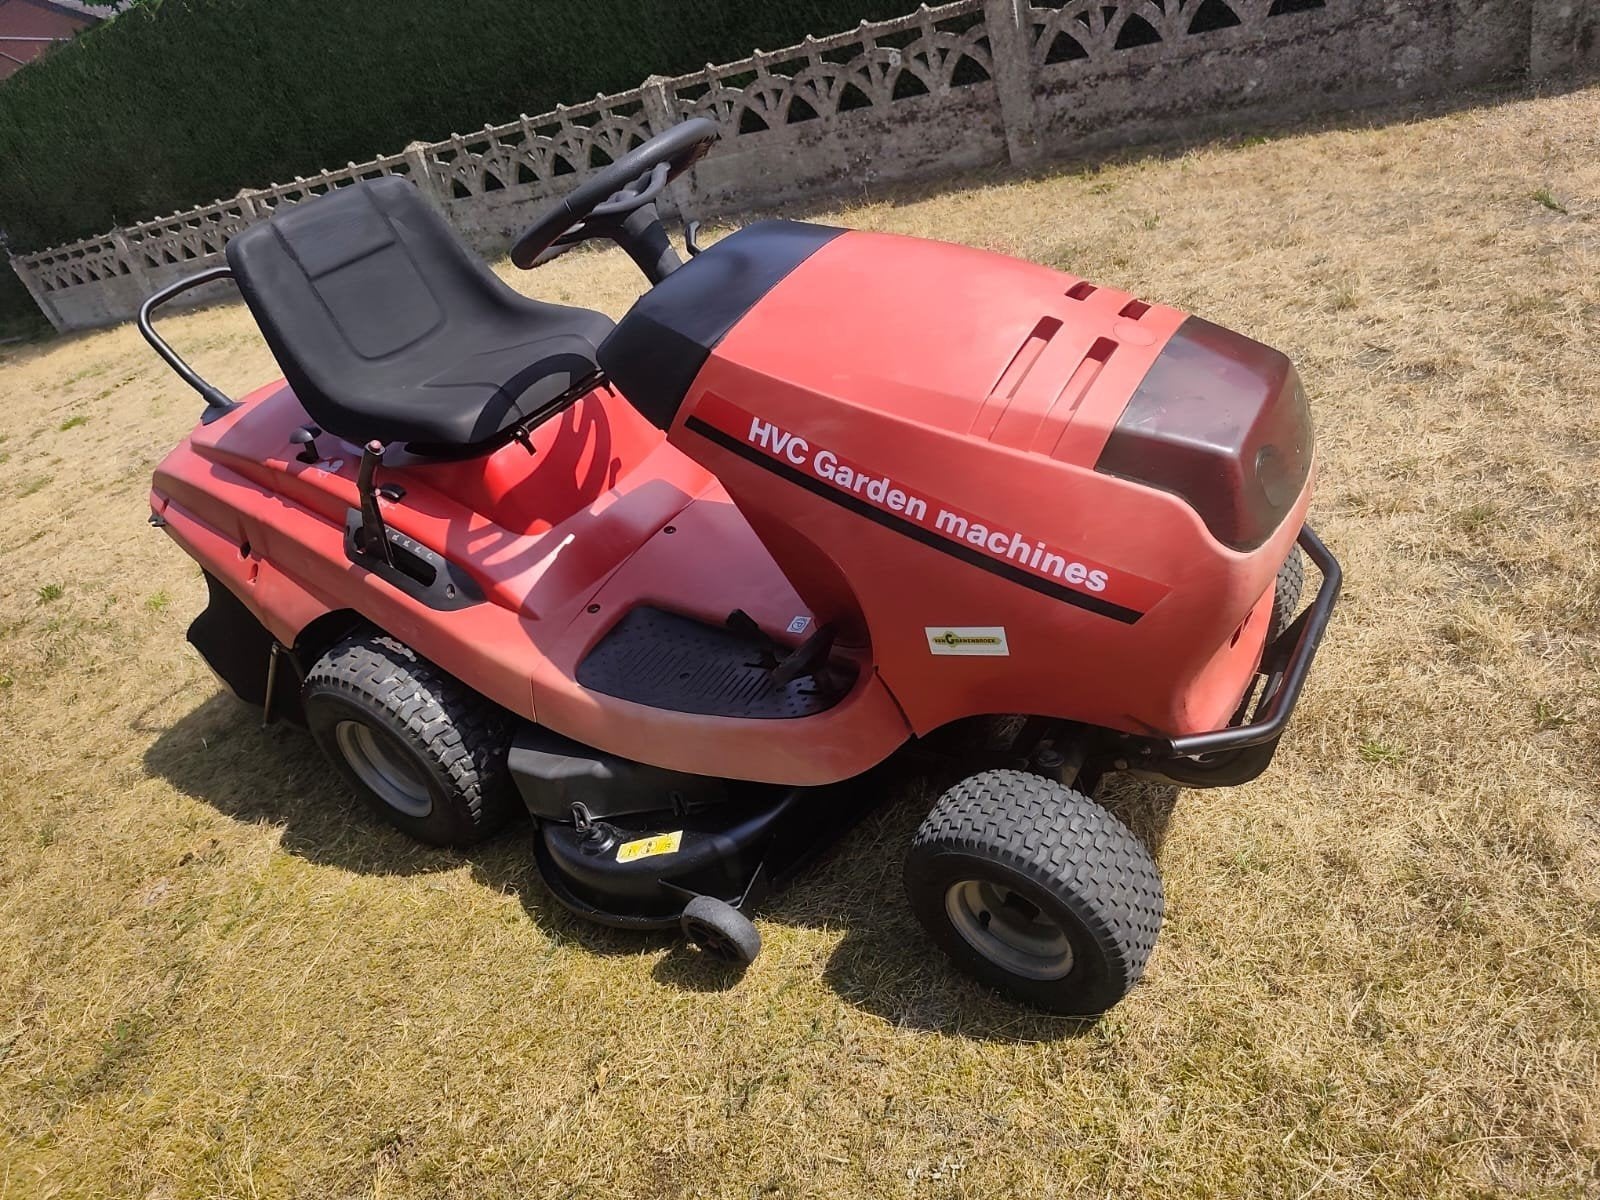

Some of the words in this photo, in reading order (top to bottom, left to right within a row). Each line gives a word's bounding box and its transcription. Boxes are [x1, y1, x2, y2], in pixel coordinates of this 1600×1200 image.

[749, 417, 808, 464] HVC
[813, 450, 927, 520] Garden
[935, 508, 1108, 592] machines
